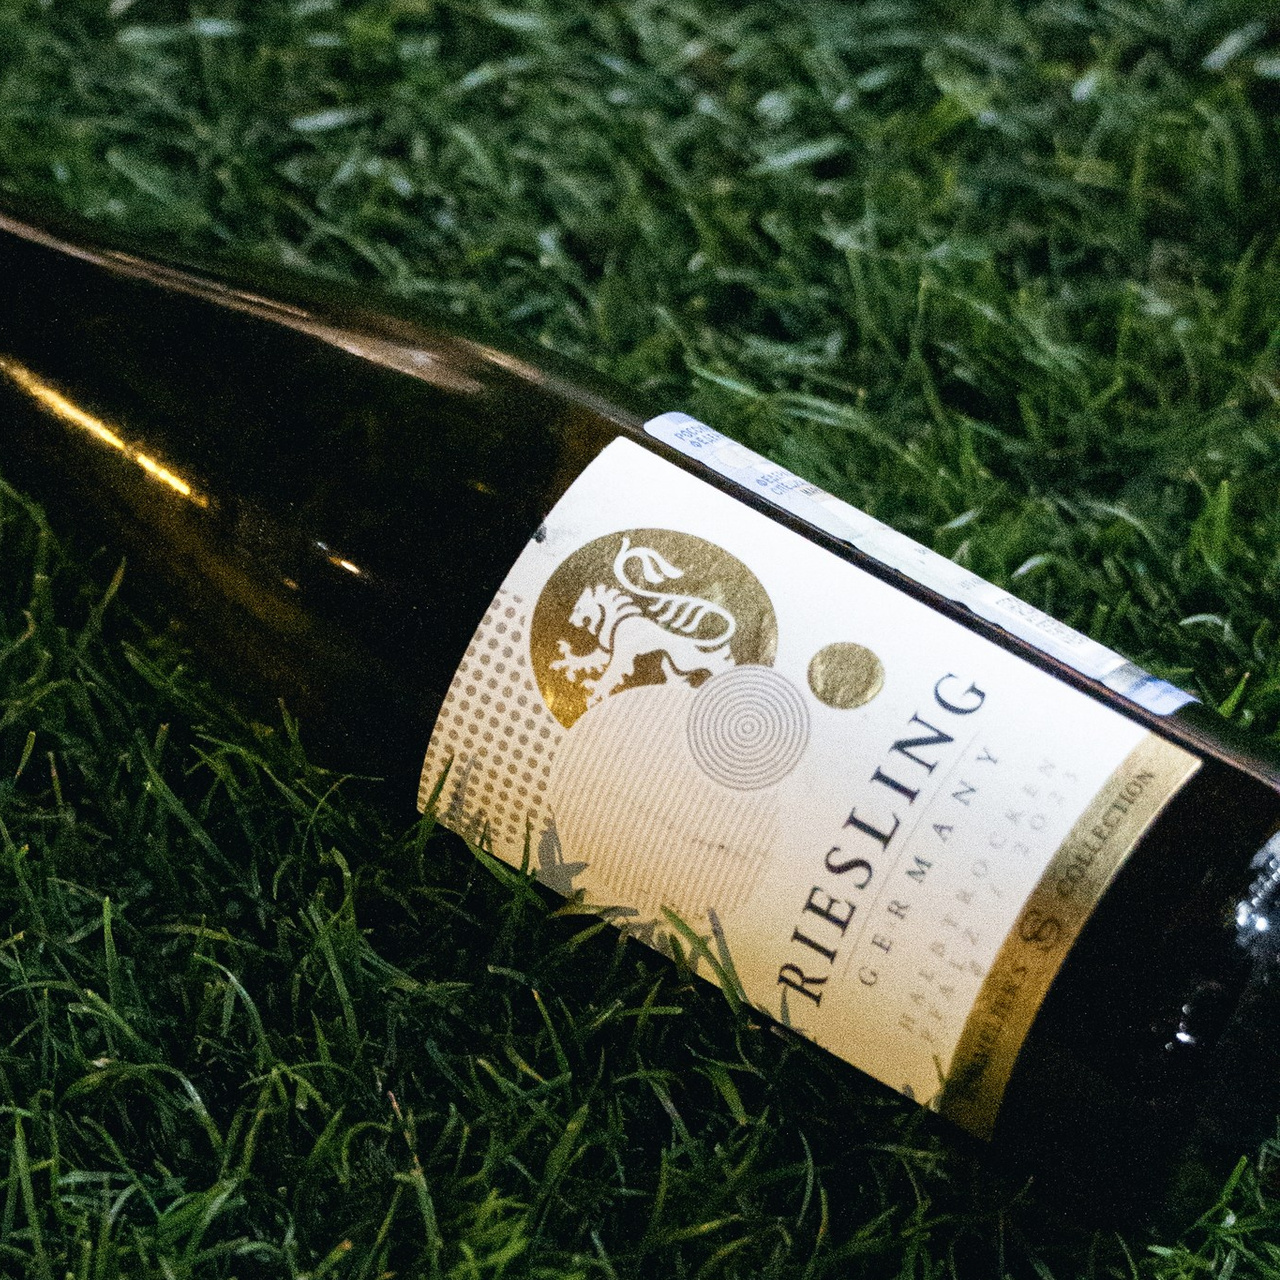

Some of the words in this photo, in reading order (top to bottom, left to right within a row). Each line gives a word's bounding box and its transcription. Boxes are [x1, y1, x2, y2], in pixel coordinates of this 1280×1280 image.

[778, 673, 986, 1007] RIESLING
[859, 747, 998, 987] GERMANY
[1057, 769, 1155, 897] COLLECTION
